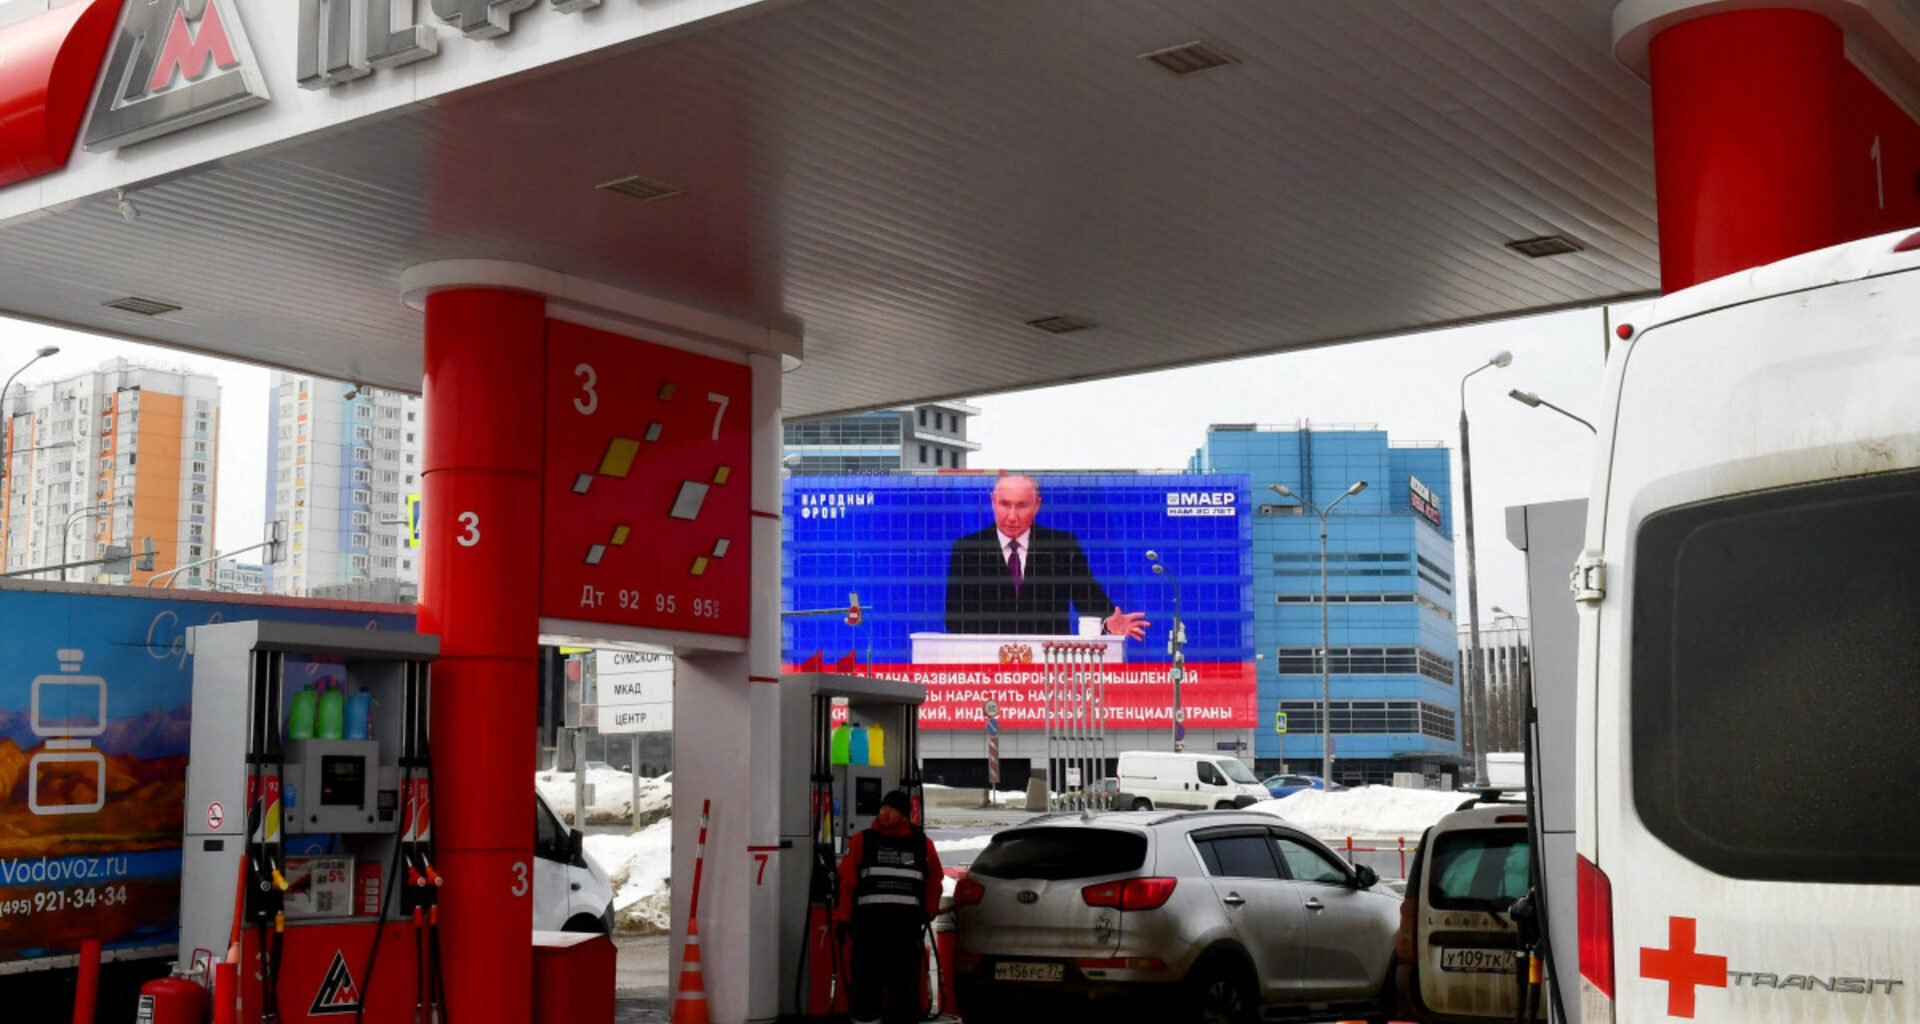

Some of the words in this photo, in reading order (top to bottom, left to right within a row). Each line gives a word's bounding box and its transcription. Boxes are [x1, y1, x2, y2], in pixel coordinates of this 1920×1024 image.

[573, 362, 599, 416] 3
[707, 392, 730, 441] 7
[801, 492, 875, 507] НАРОДНЫЙ
[1168, 507, 1193, 515] НАМ
[1196, 507, 1210, 515] 20
[1212, 507, 1233, 515] ЛЕТ
[801, 507, 847, 519] ФРОНТ
[456, 511, 481, 547] 3
[619, 589, 640, 610] 92
[656, 593, 676, 614] 95
[614, 682, 642, 696] МКАД
[914, 673, 991, 685] РАЗВИВАТЬ
[946, 690, 1025, 702] НАРАСТИТЬ
[615, 712, 647, 726] ЦЕНТР
[1180, 707, 1232, 720] ТРАНЫ
[1, 856, 128, 884] Vodovoz.ru
[511, 861, 529, 897] 3
[754, 854, 768, 886] 7
[818, 925, 828, 948] 7
[1727, 970, 1904, 995] TRANSIT
